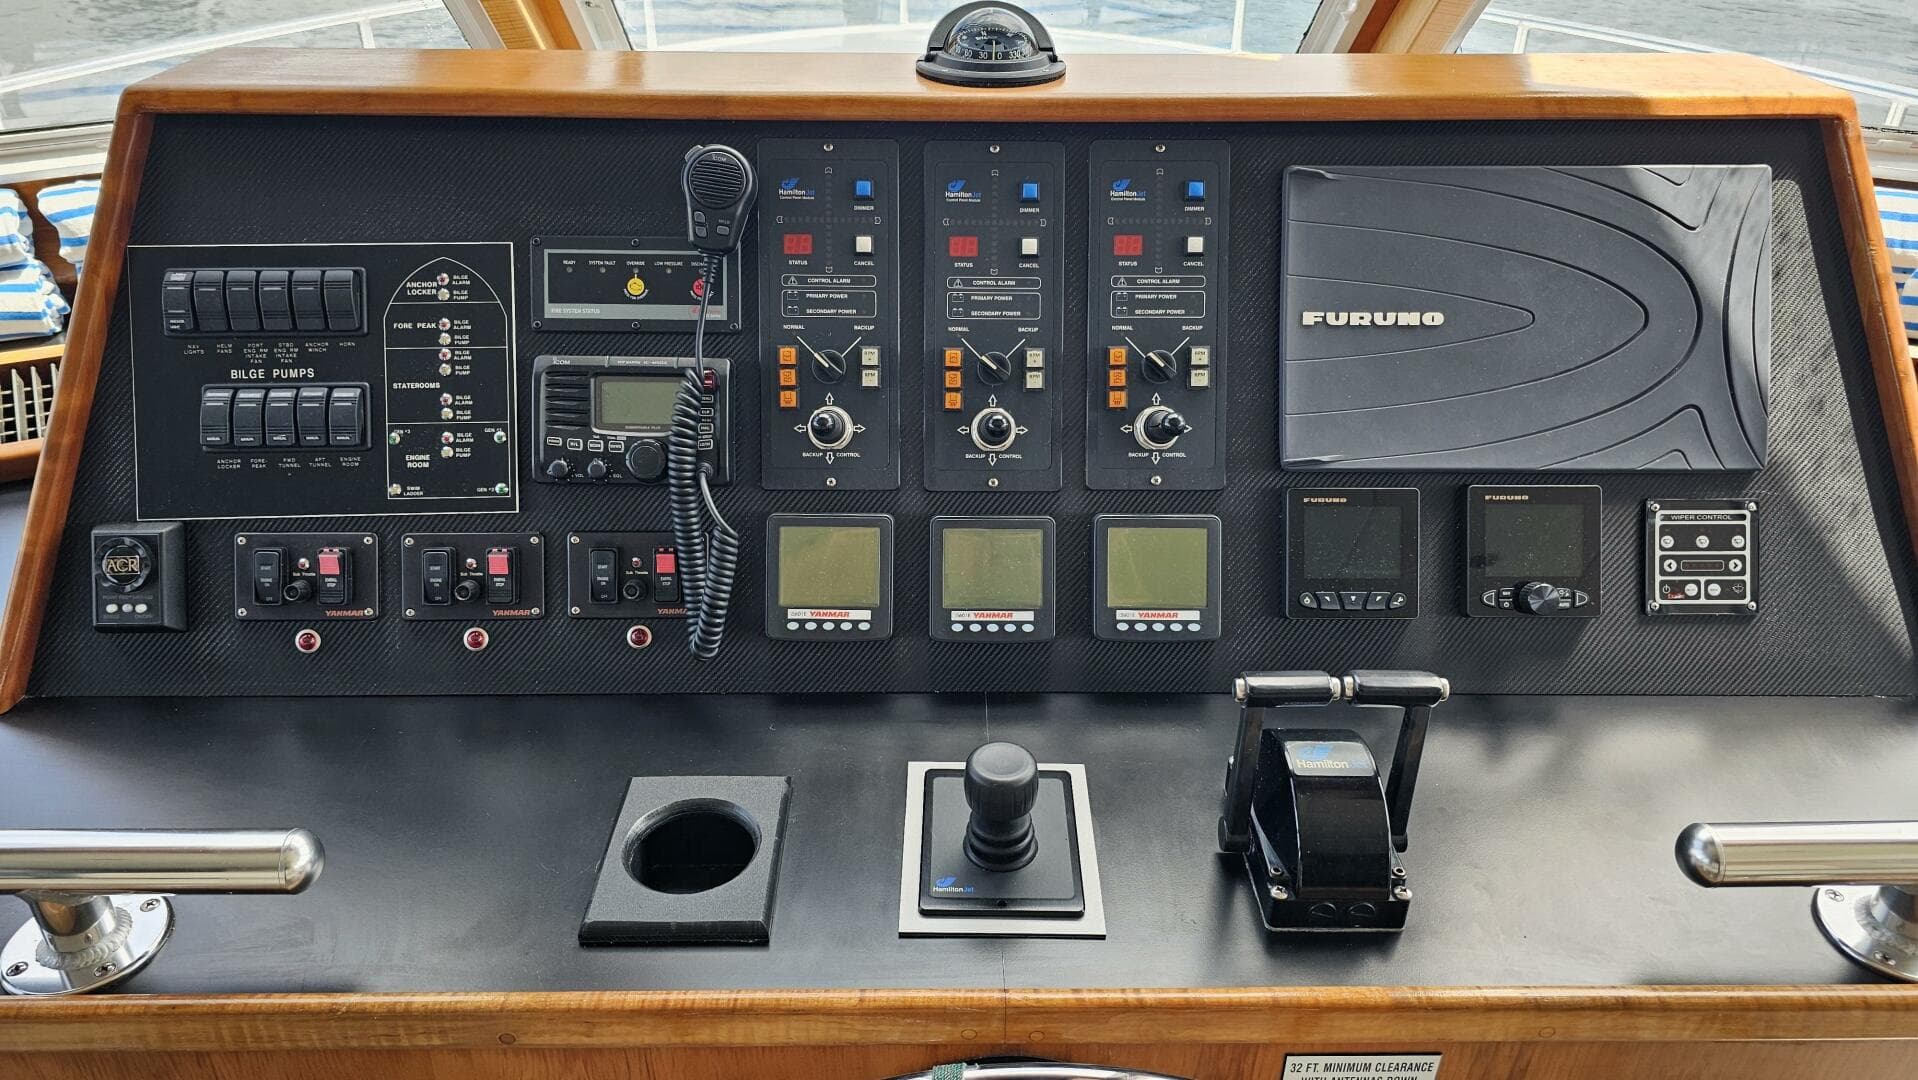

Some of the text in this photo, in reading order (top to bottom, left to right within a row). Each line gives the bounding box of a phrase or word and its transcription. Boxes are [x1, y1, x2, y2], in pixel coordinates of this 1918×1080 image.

[978, 51, 988, 59] 30
[1302, 311, 1445, 326] FURUNO
[230, 368, 315, 379] BILGE PUMPS
[107, 558, 138, 572] ACR
[1290, 1062, 1435, 1073] 32 FT. MINIMUM CLEARANCE
